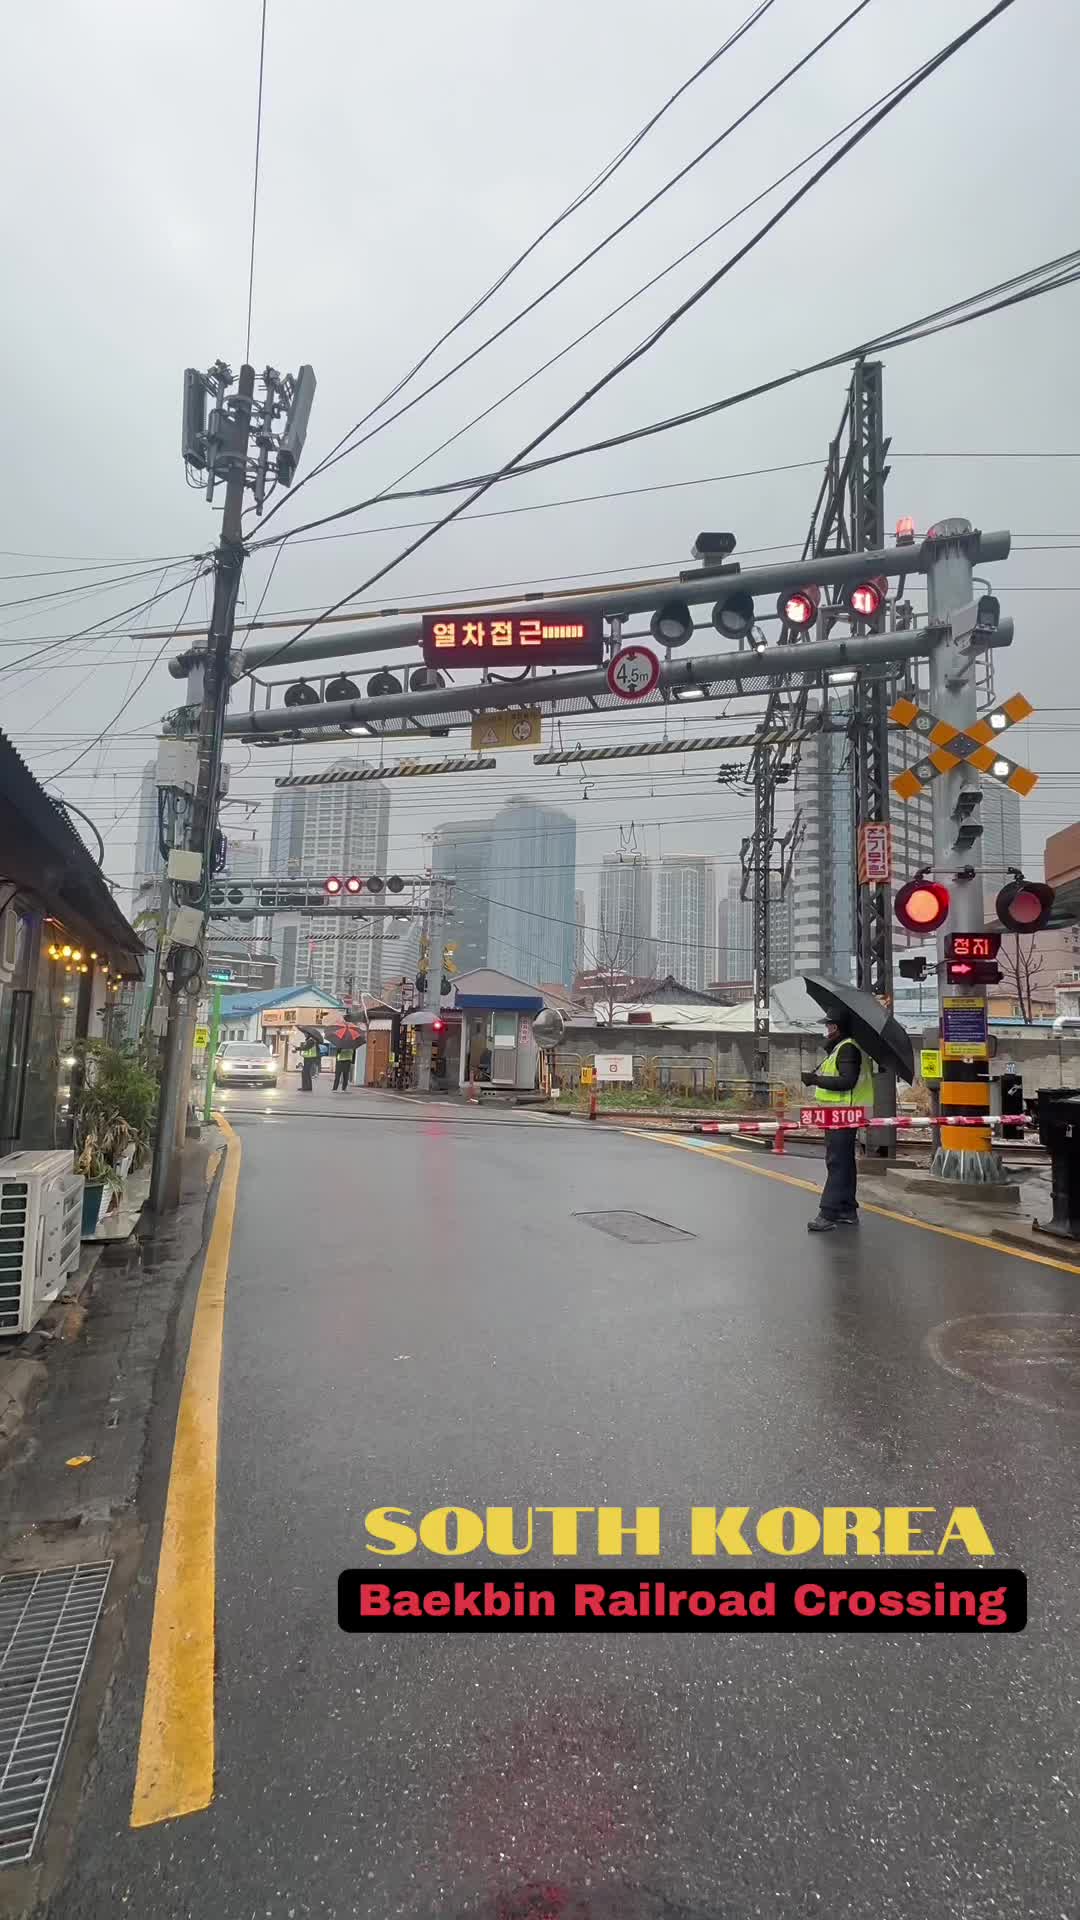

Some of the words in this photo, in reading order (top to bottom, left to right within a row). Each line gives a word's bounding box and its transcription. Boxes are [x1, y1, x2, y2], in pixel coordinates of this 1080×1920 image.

[433, 620, 542, 648] 열차접근
[616, 663, 649, 684] 4.5m
[867, 827, 886, 876] 전기위험
[954, 938, 989, 955] 정지
[801, 1110, 825, 1124] 정지
[832, 1109, 862, 1123] STOP
